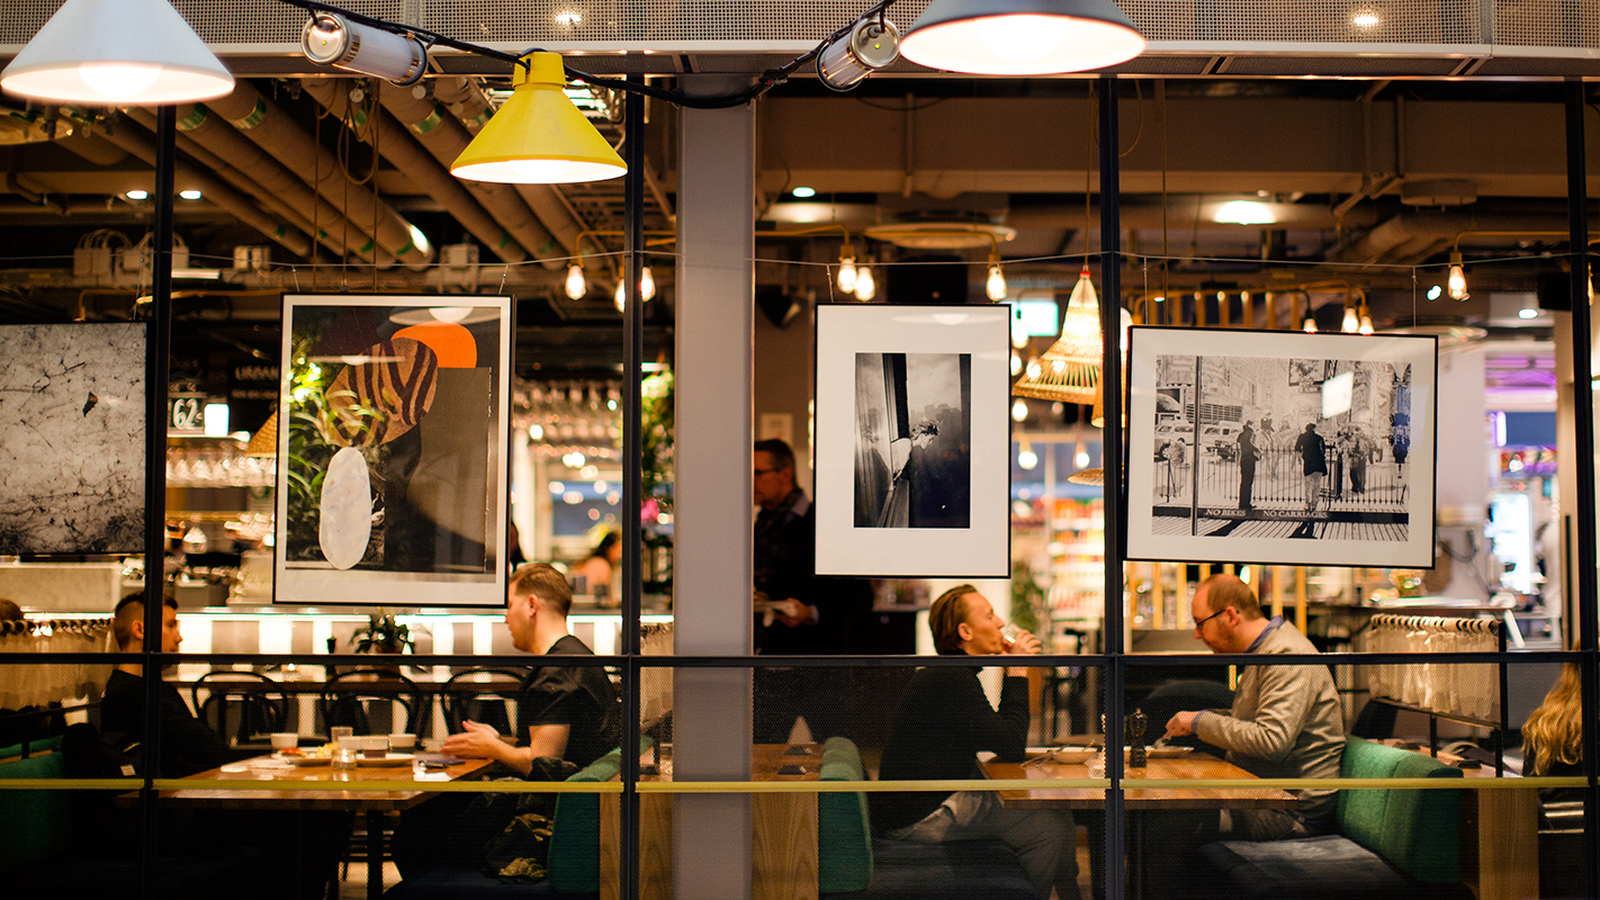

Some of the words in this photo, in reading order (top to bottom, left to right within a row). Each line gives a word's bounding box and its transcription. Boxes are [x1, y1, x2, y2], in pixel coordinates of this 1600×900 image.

[1205, 508, 1221, 517] NO
[1221, 509, 1246, 517] BIKES
[1263, 510, 1277, 518] NO
[1278, 510, 1329, 519] CARRIAGES
